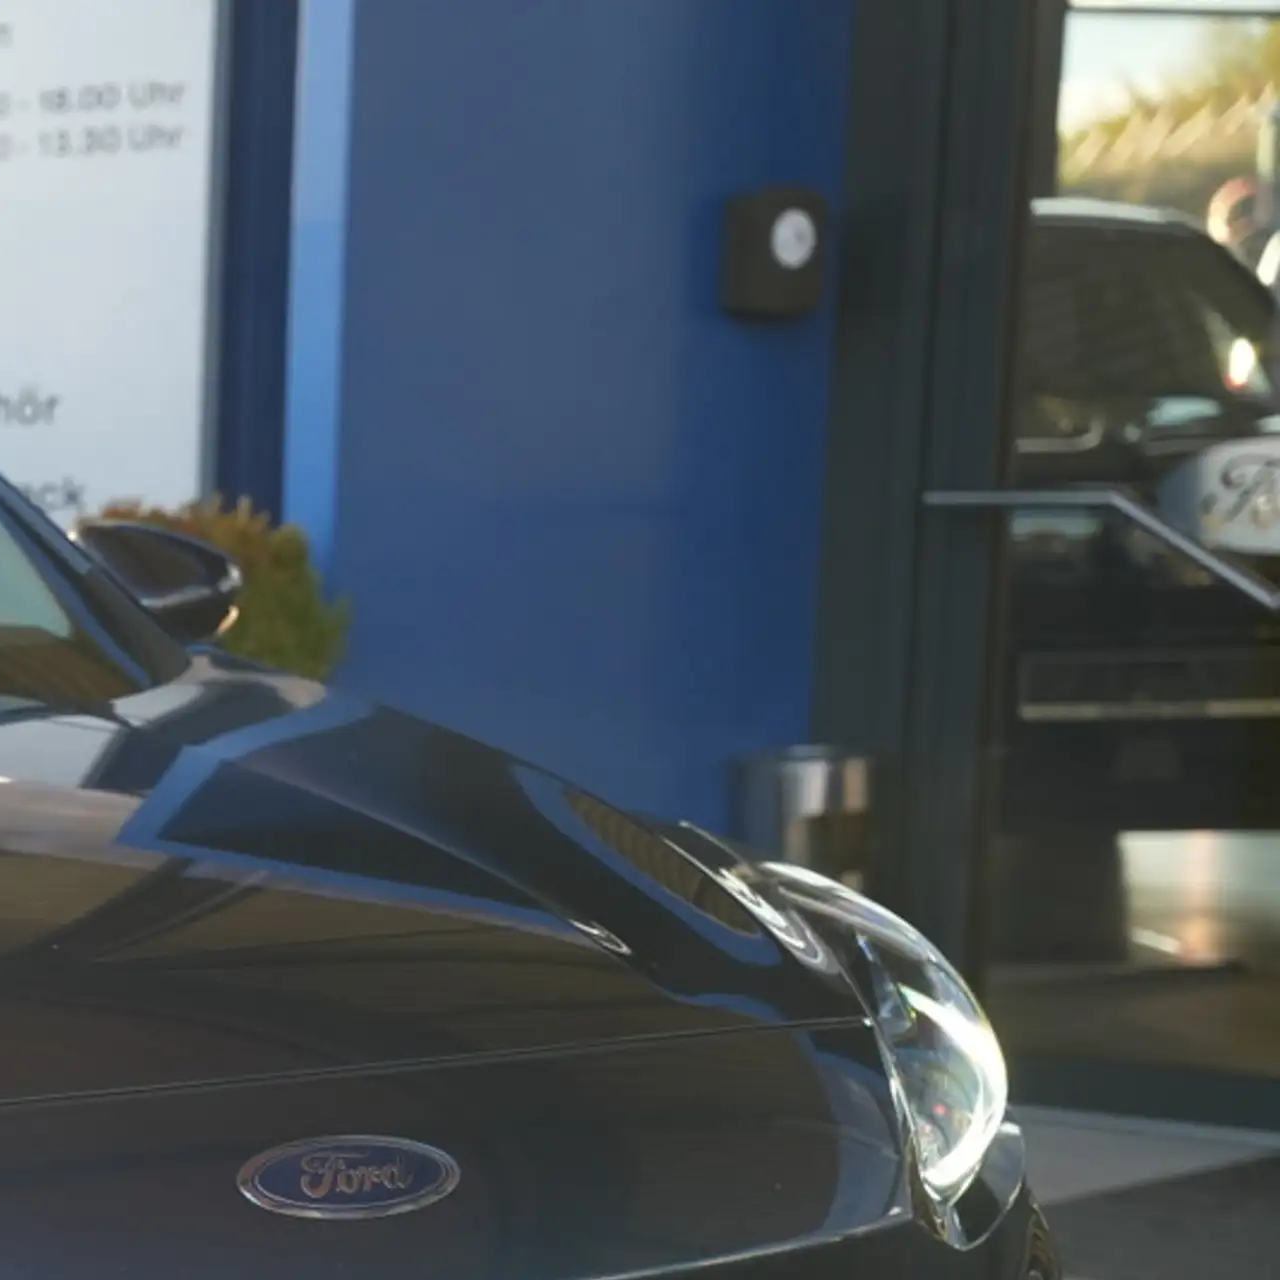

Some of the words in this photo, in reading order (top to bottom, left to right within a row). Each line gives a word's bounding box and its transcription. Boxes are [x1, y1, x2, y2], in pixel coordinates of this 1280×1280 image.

[127, 81, 184, 111] Uhr
[127, 124, 183, 153] Uhr
[300, 1151, 413, 1198] Ford
